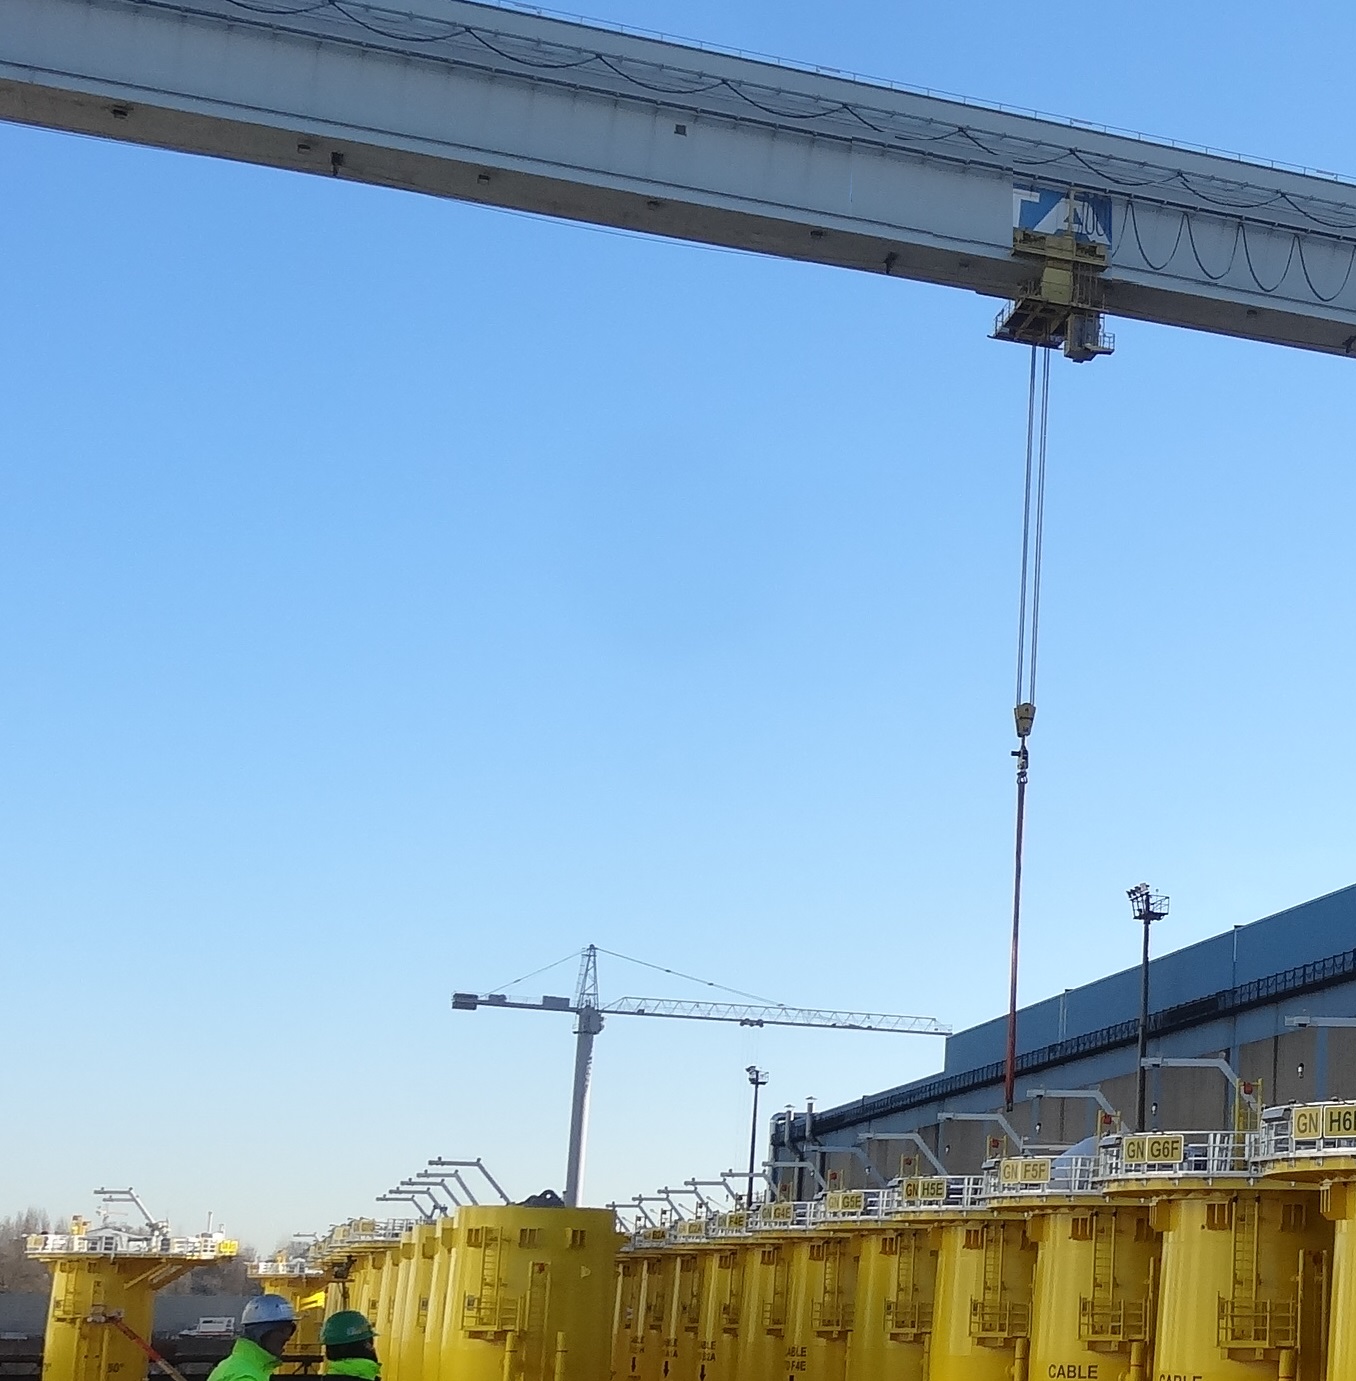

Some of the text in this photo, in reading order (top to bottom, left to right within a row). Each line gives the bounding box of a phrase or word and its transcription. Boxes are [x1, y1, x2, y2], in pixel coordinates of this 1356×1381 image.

[1296, 1113, 1319, 1135] GN
[1127, 1140, 1180, 1158] GN G6F
[1003, 1163, 1046, 1179] GN F5F
[905, 1182, 944, 1196] GN H5E
[842, 1195, 862, 1208] G5E
[1048, 1363, 1099, 1379] CABLE
